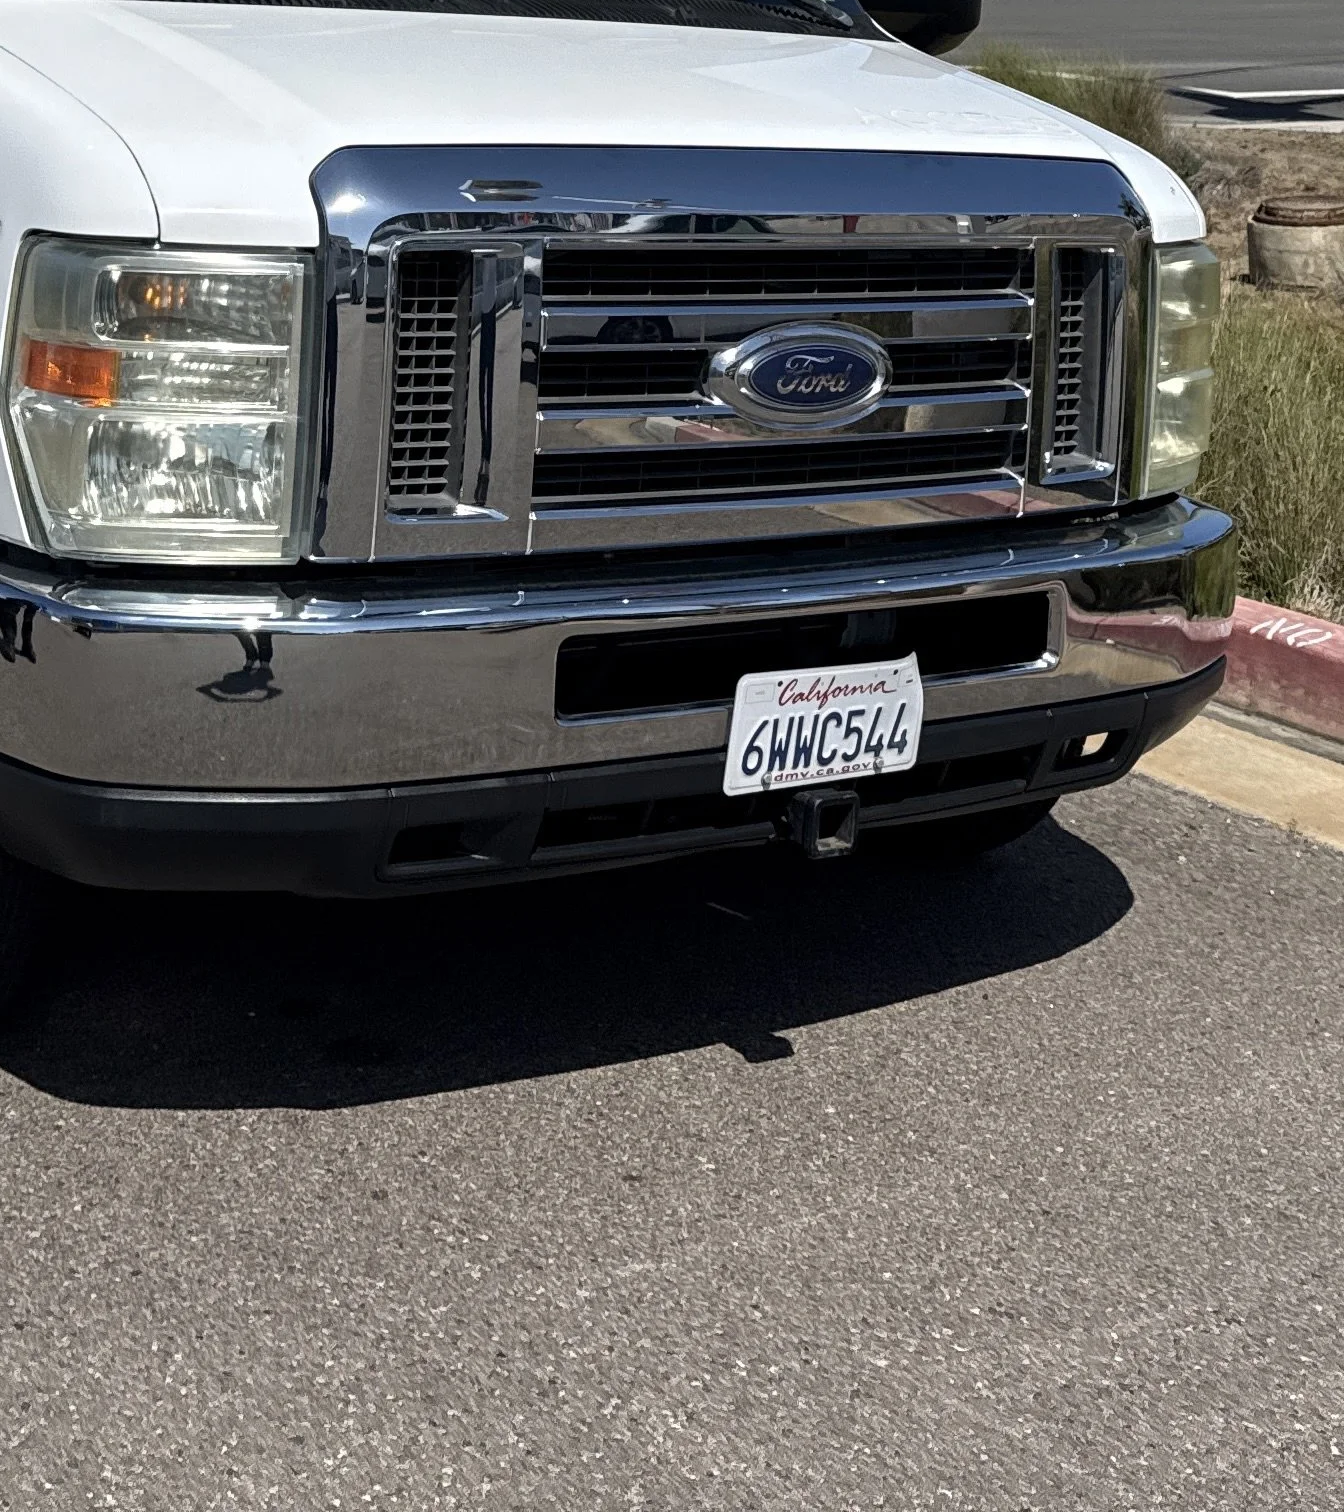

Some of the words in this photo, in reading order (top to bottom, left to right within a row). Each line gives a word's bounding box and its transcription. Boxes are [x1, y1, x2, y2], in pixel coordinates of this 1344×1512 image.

[776, 354, 853, 395] Ford
[1249, 617, 1332, 648] NO
[778, 675, 897, 710] California
[741, 702, 908, 776] 6WWC544
[774, 761, 872, 782] dmv.ca.gov
